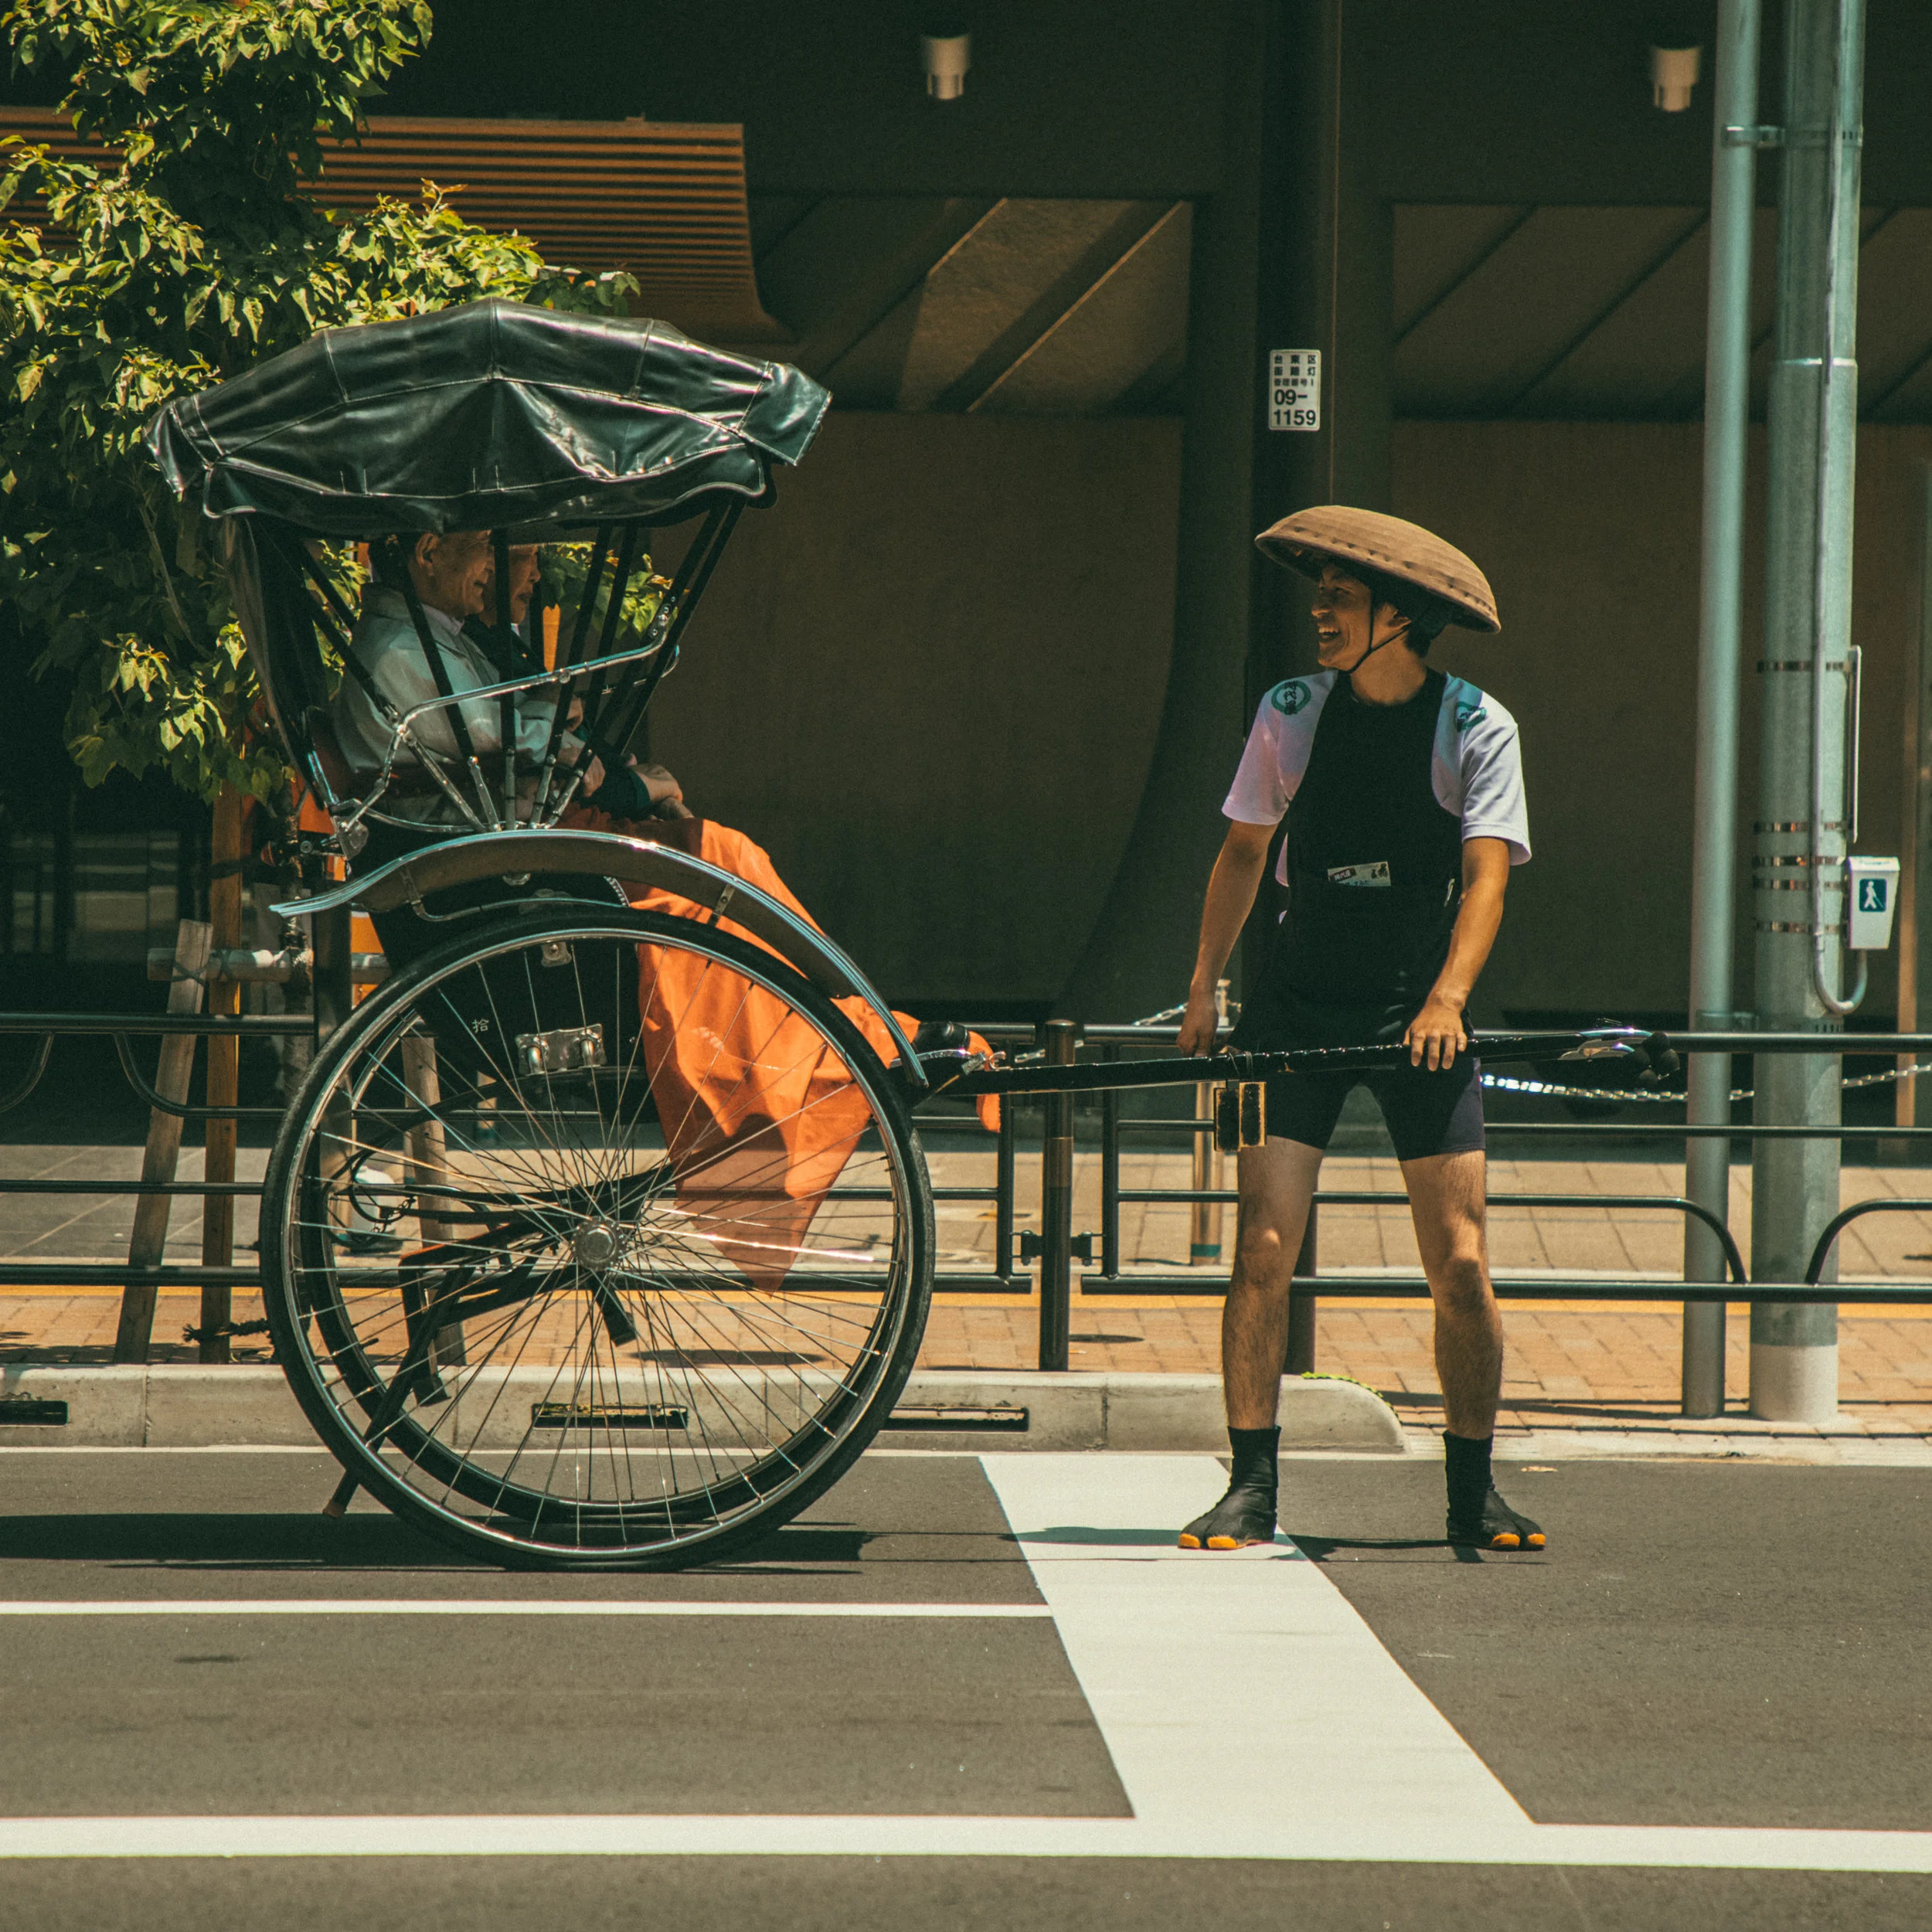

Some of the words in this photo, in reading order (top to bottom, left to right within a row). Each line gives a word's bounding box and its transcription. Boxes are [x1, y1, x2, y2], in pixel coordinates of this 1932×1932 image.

[1274, 354, 1316, 364] 台東区
[1274, 409, 1316, 426] 1159
[471, 1019, 489, 1033] 拾
